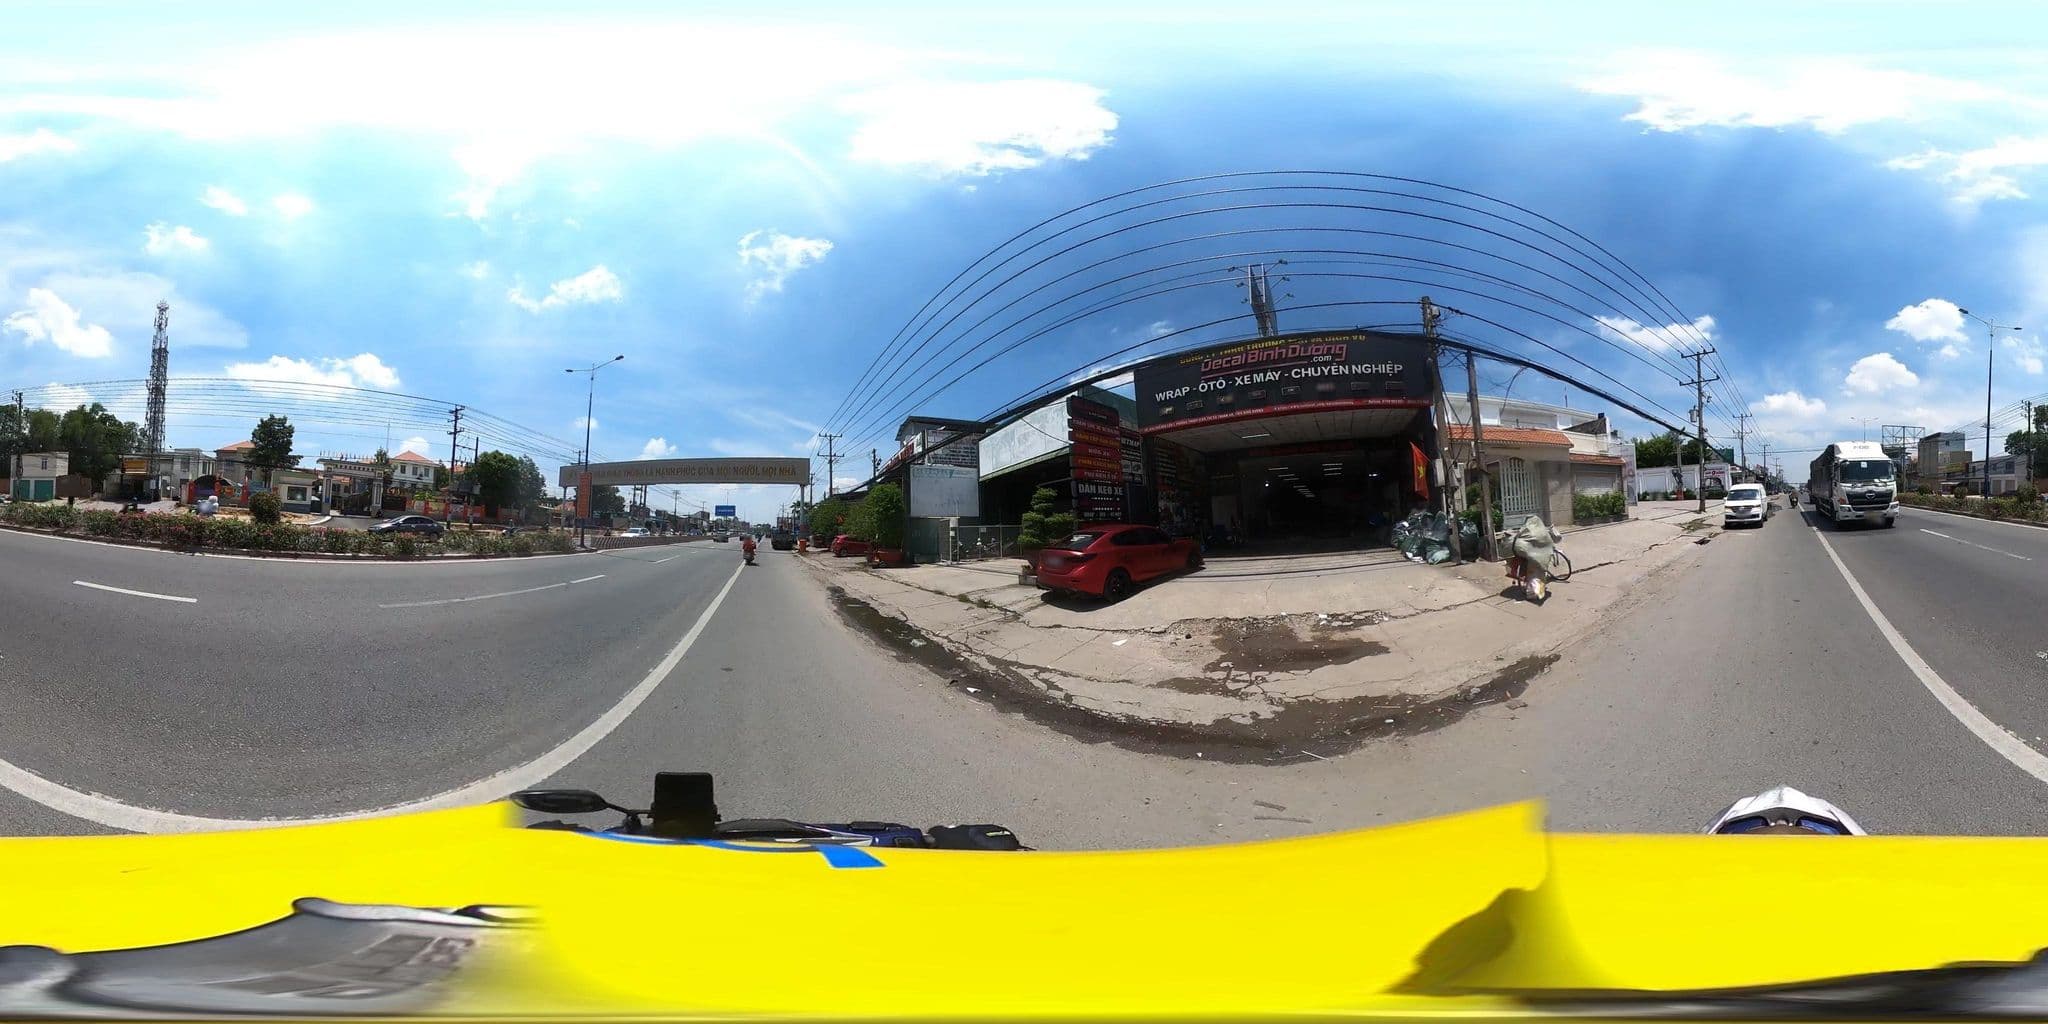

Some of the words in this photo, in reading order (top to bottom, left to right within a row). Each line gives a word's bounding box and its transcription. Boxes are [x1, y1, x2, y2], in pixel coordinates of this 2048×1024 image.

[1155, 386, 1190, 402] WRAP
[1235, 374, 1251, 387] XE
[1291, 362, 1349, 379] CHUYÊN
[1352, 360, 1403, 377] NGHIỆP
